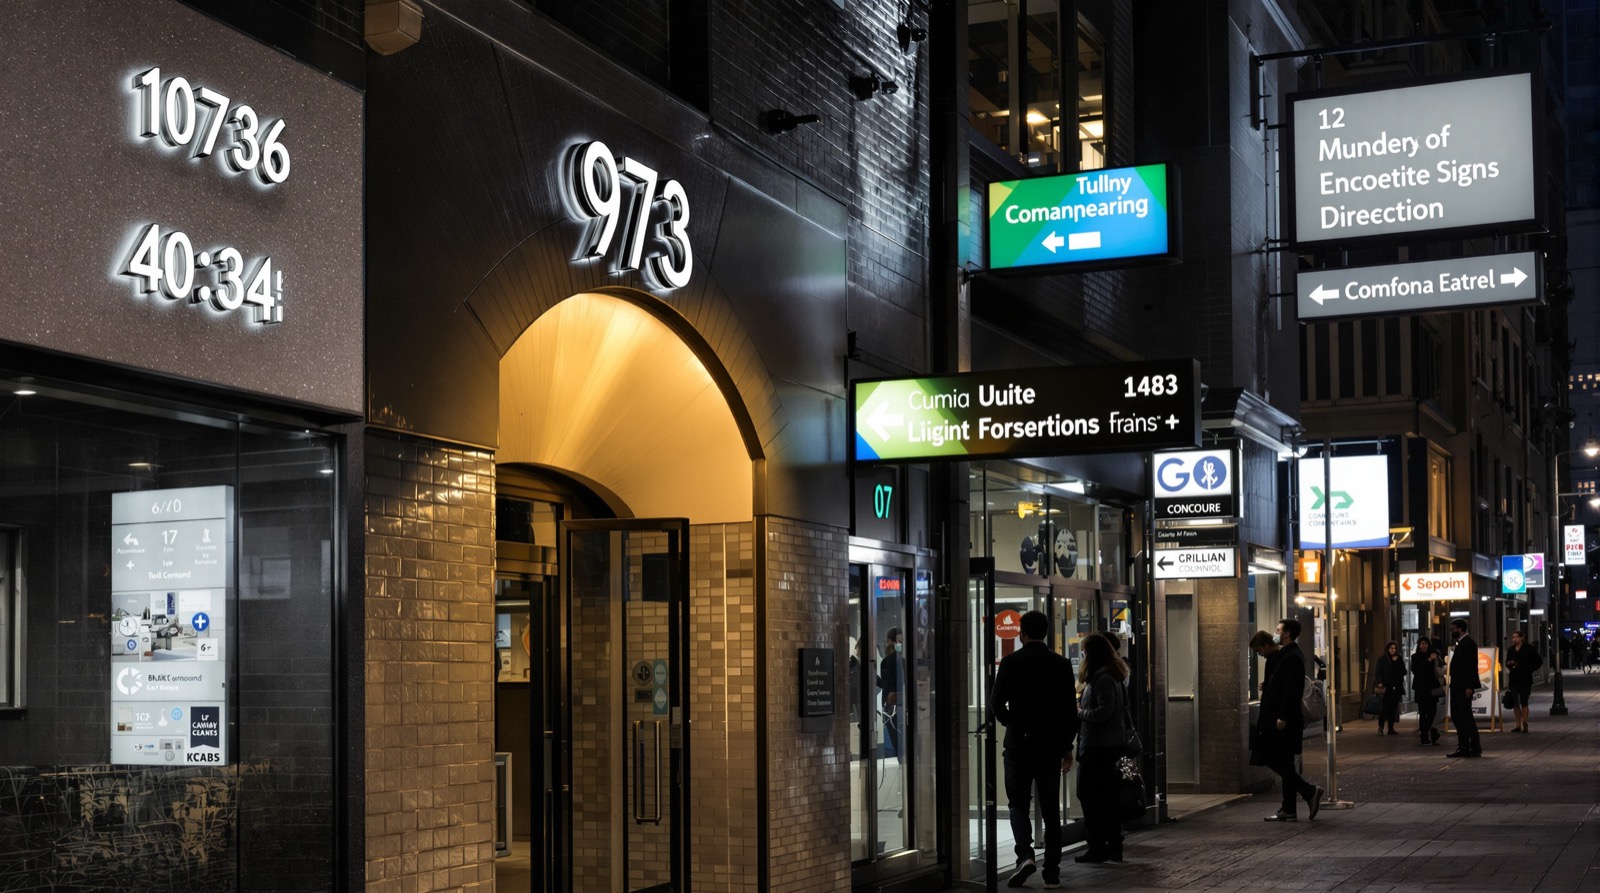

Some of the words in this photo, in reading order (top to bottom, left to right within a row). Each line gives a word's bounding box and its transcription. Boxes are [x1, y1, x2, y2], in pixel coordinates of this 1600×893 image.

[131, 66, 291, 185] 10736
[1318, 107, 1345, 130] 12
[1425, 124, 1451, 149] of
[1076, 174, 1132, 196] Tullny
[1320, 165, 1430, 196] Encoetite
[1436, 160, 1500, 187] Signs
[566, 140, 693, 290] 973
[1345, 277, 1434, 302] Comfona
[1440, 269, 1496, 293] Eatrel
[908, 388, 970, 410] Cumia
[978, 383, 1035, 407] Uuite
[1124, 374, 1179, 398] 1483
[978, 413, 1100, 440] Forsertions
[875, 484, 892, 518] 07
[1167, 503, 1221, 514] CONCOURE
[162, 529, 178, 545] 17
[1417, 577, 1465, 592] Sepoim
[187, 752, 220, 762] KCABS
